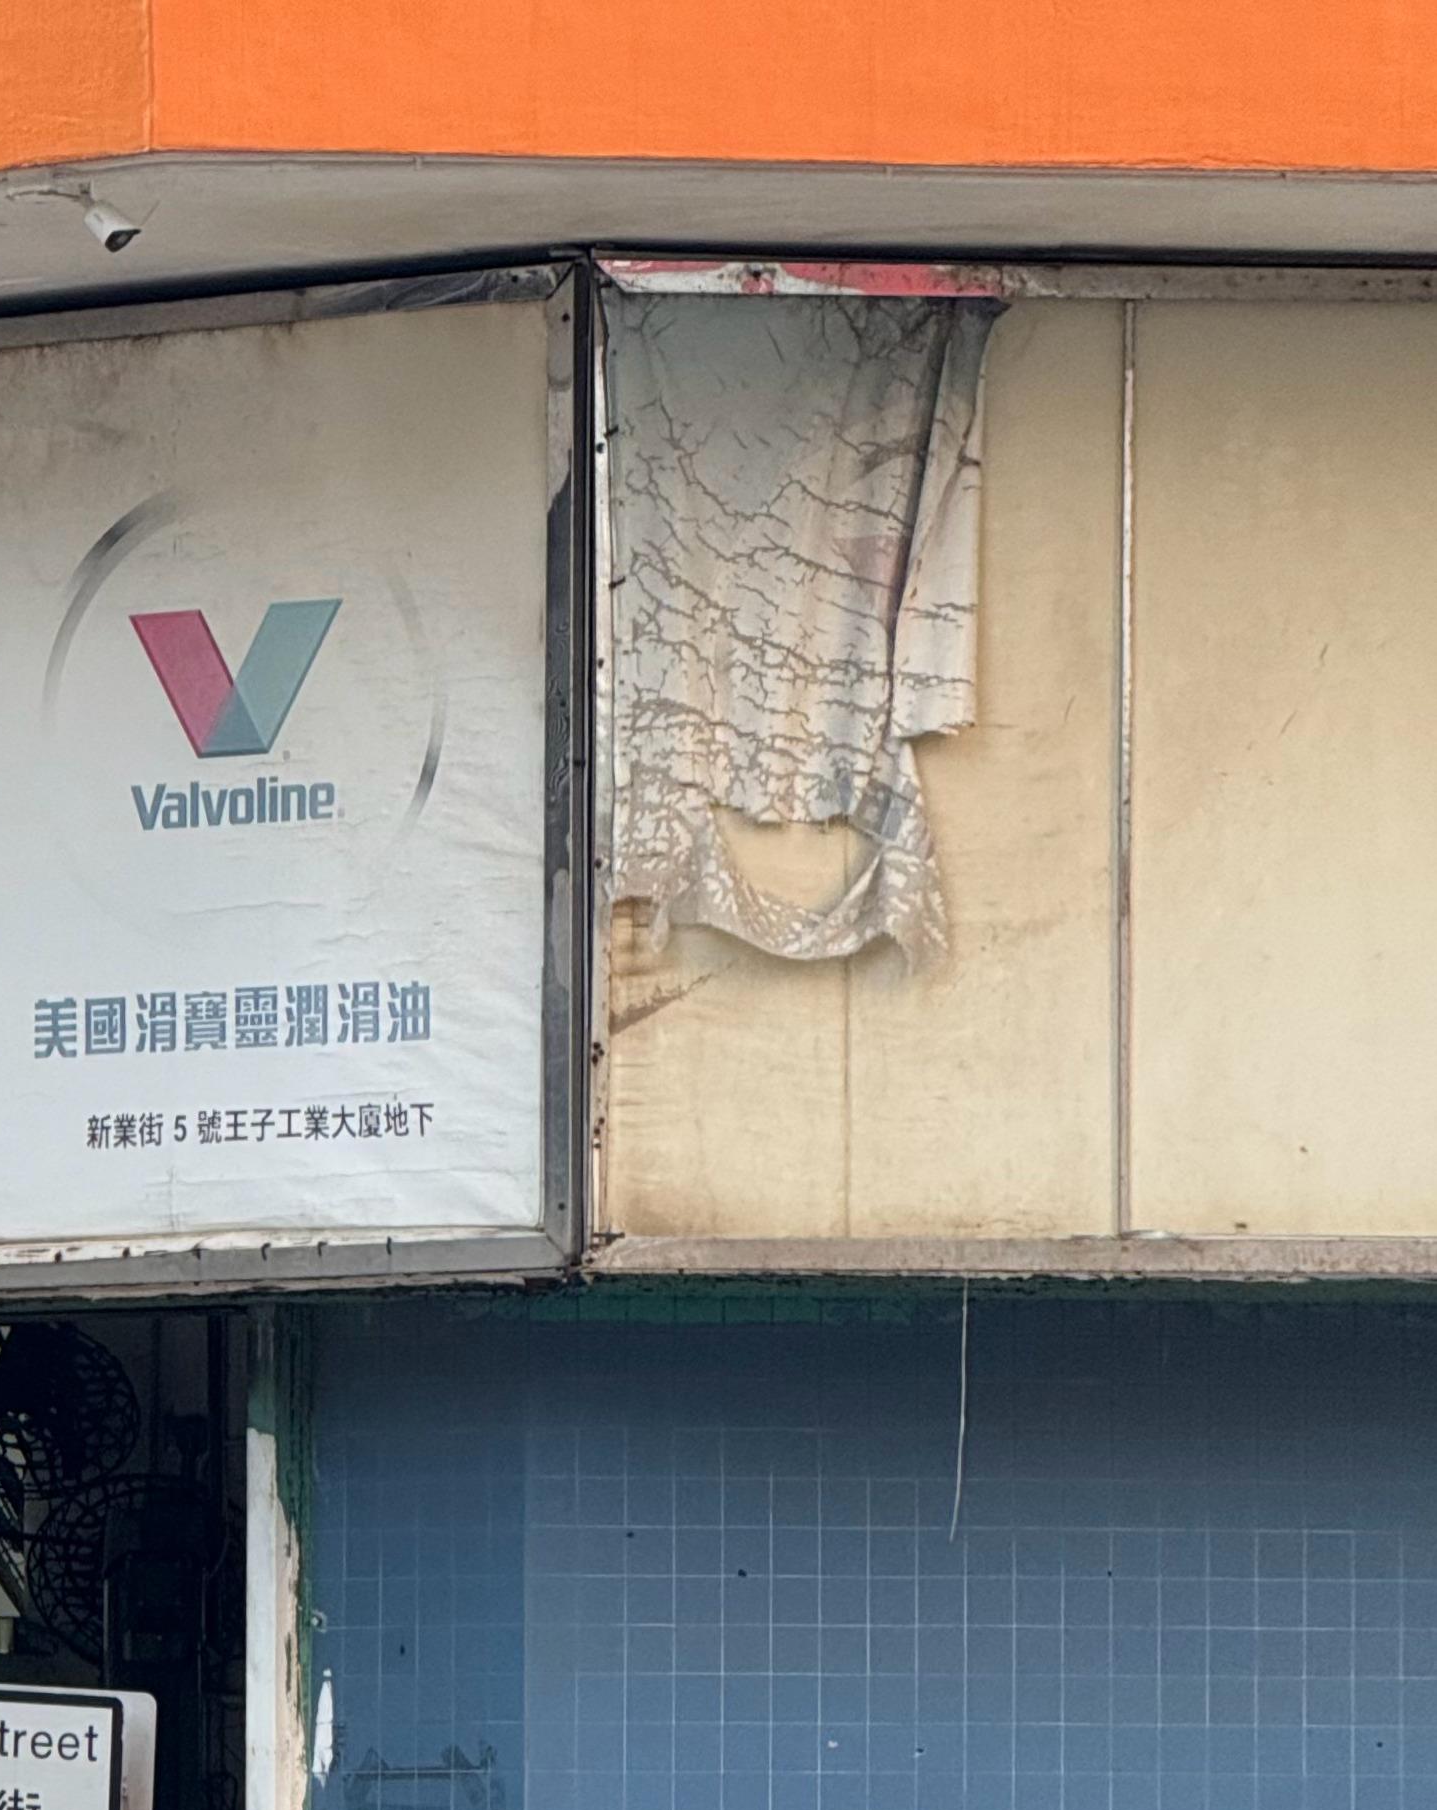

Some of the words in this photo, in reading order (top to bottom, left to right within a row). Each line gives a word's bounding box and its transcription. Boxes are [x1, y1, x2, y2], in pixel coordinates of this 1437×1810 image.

[130, 776, 335, 831] Valvoline
[86, 1111, 164, 1150] 新業街
[173, 1114, 188, 1143] 5
